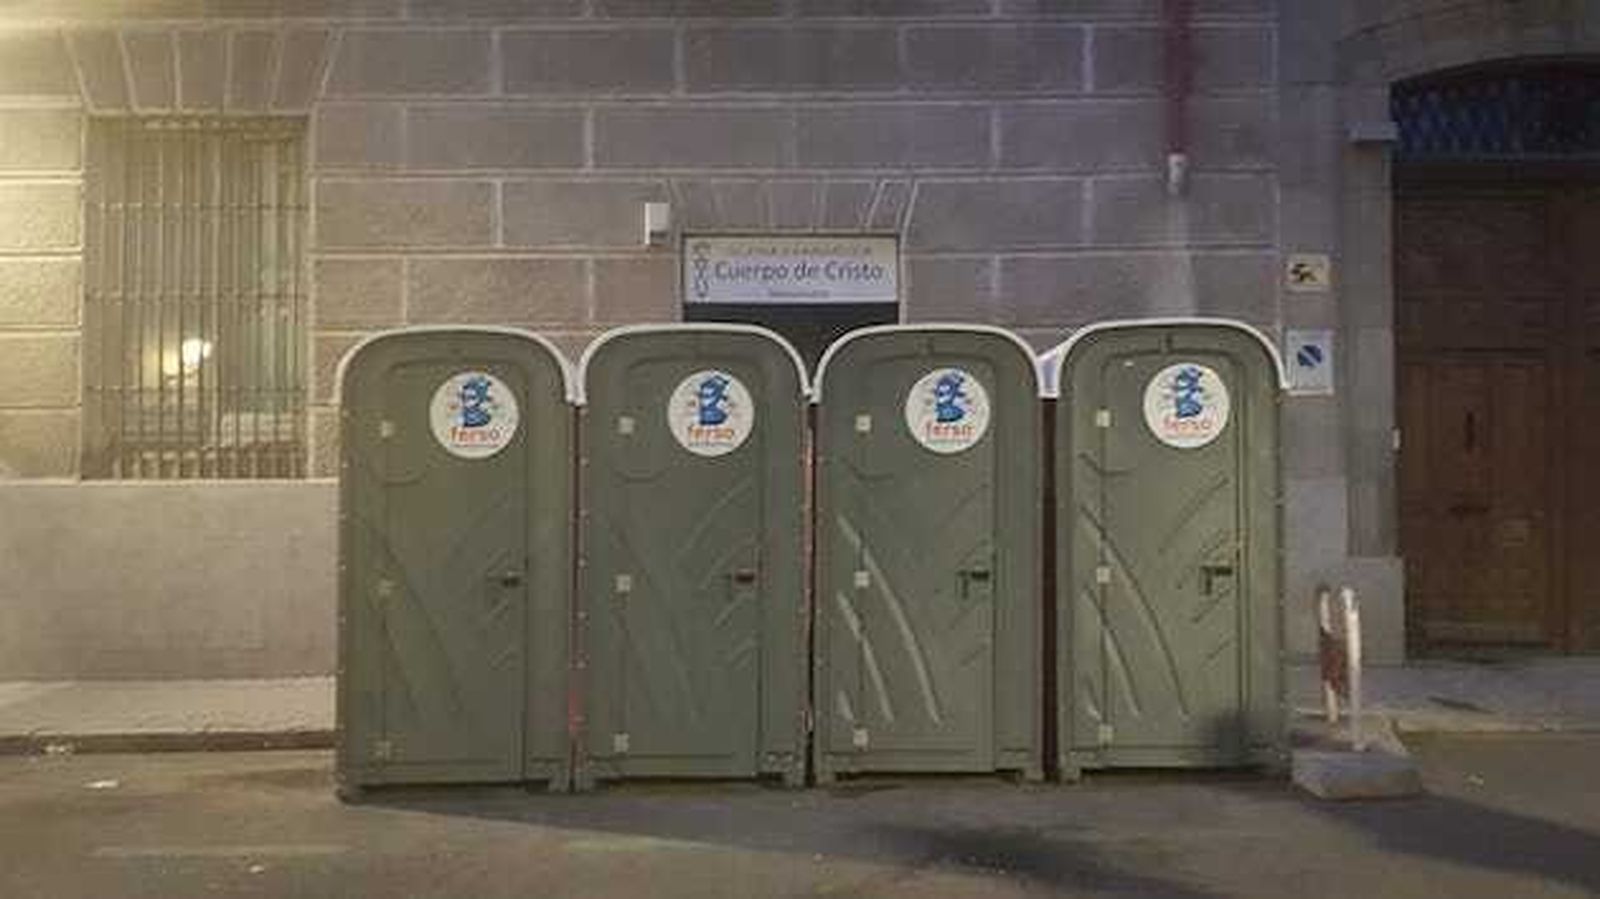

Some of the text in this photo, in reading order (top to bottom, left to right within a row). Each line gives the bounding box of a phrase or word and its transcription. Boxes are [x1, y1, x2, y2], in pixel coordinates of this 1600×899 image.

[714, 260, 884, 284] Cuerpo de Cristo
